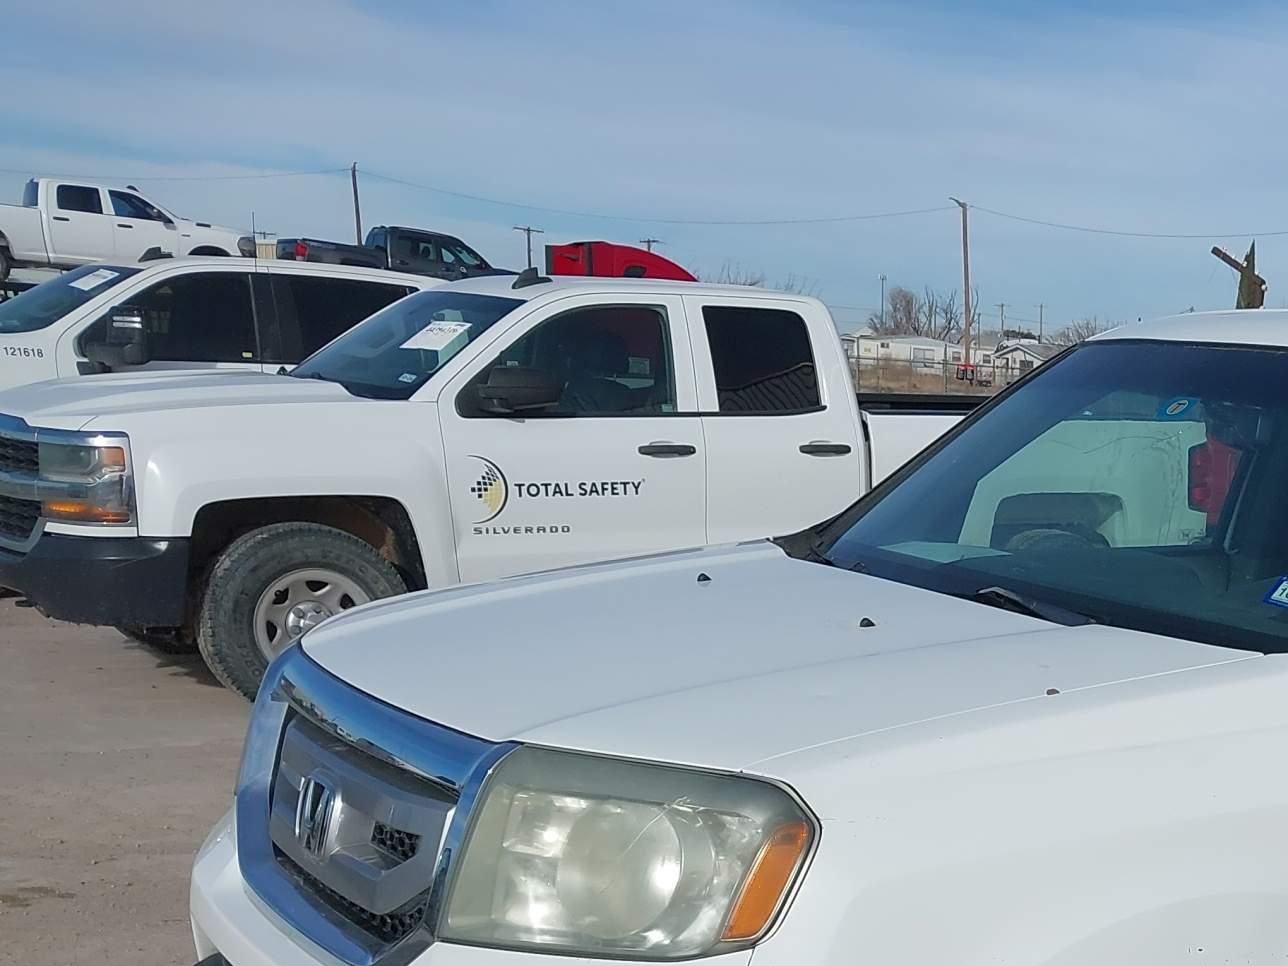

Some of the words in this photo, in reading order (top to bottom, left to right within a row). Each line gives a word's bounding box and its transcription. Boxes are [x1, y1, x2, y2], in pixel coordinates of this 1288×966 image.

[3, 346, 44, 359] 121618
[513, 482, 575, 498] TOTAL
[578, 481, 642, 497] SAFETY
[472, 525, 571, 536] SILVERADO
